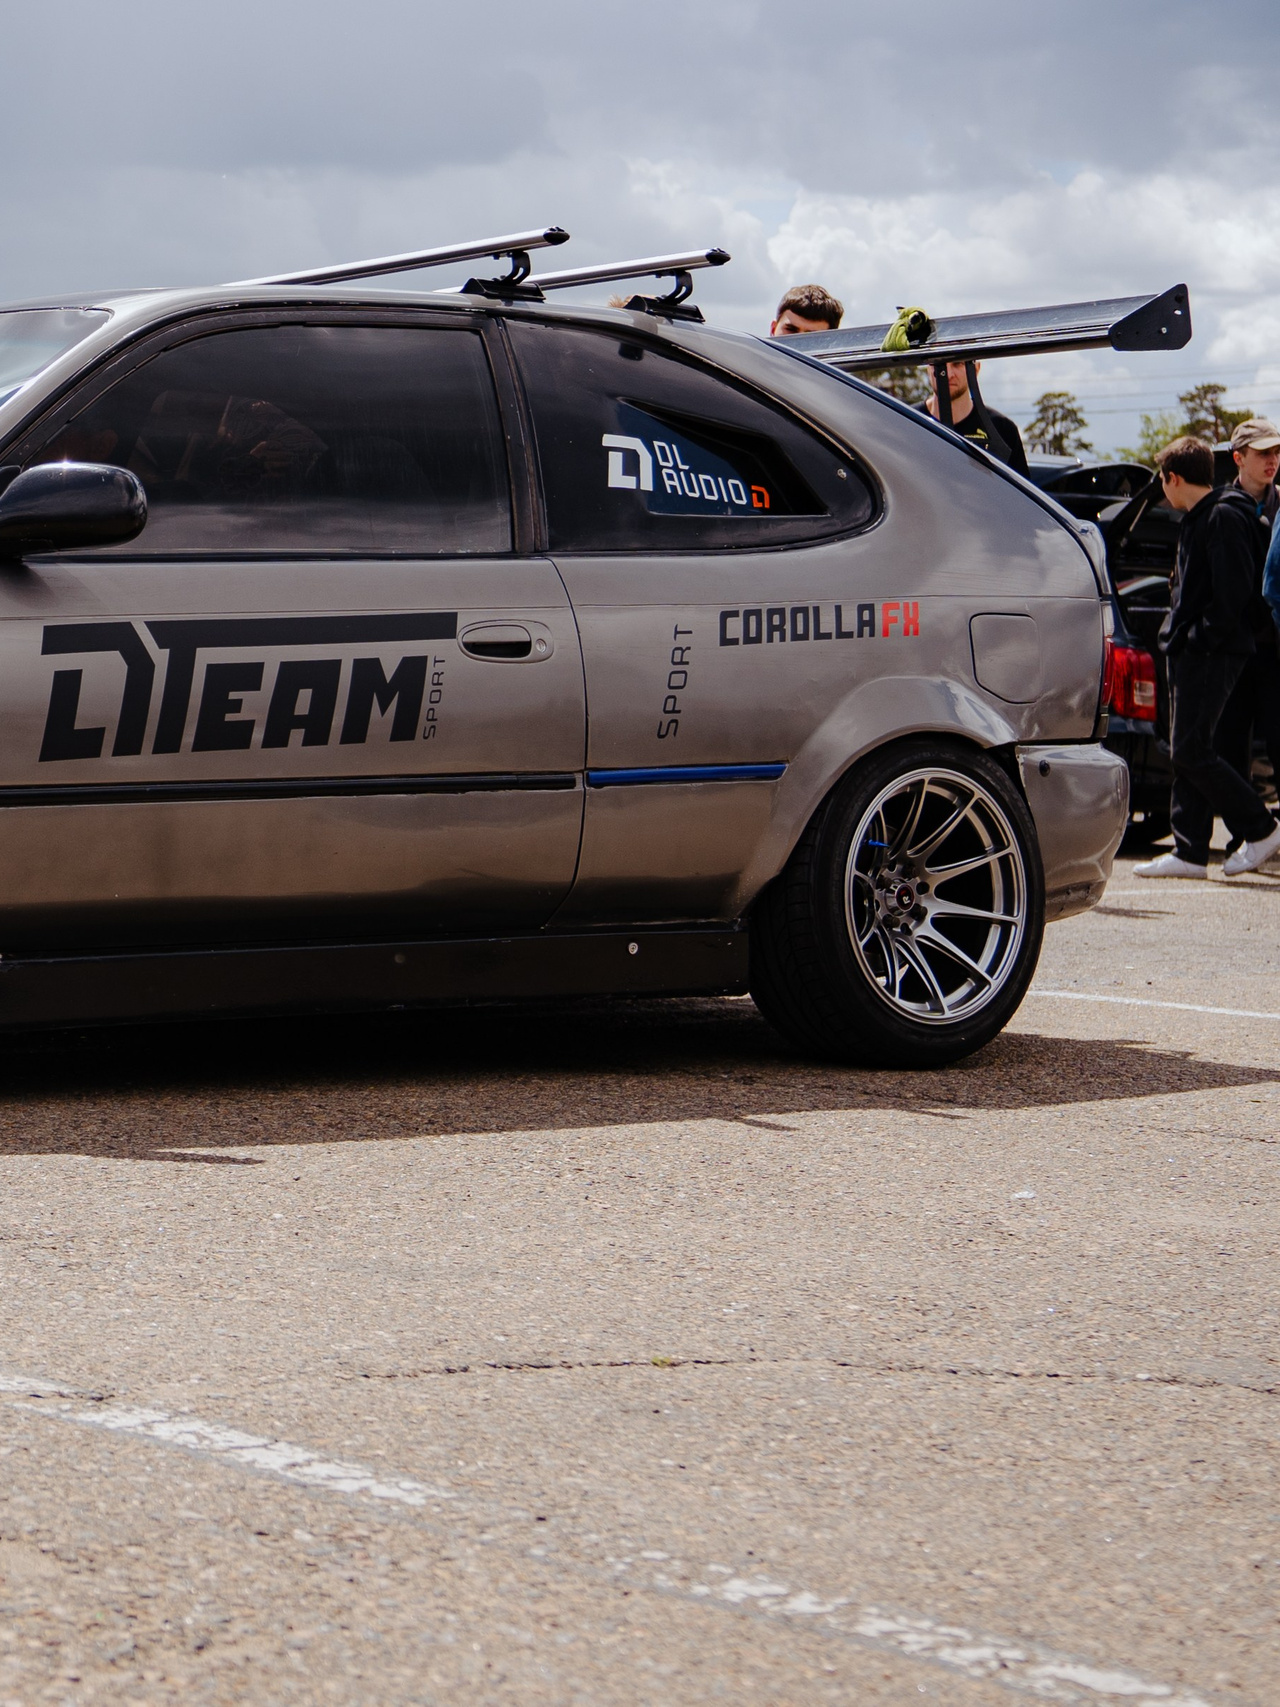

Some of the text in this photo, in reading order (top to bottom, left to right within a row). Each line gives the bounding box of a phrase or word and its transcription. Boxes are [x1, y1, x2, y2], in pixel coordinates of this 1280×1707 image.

[653, 440, 690, 470] DL
[662, 467, 748, 506] AUDIO
[423, 655, 446, 740] SPORT
[657, 624, 694, 739] SPORT
